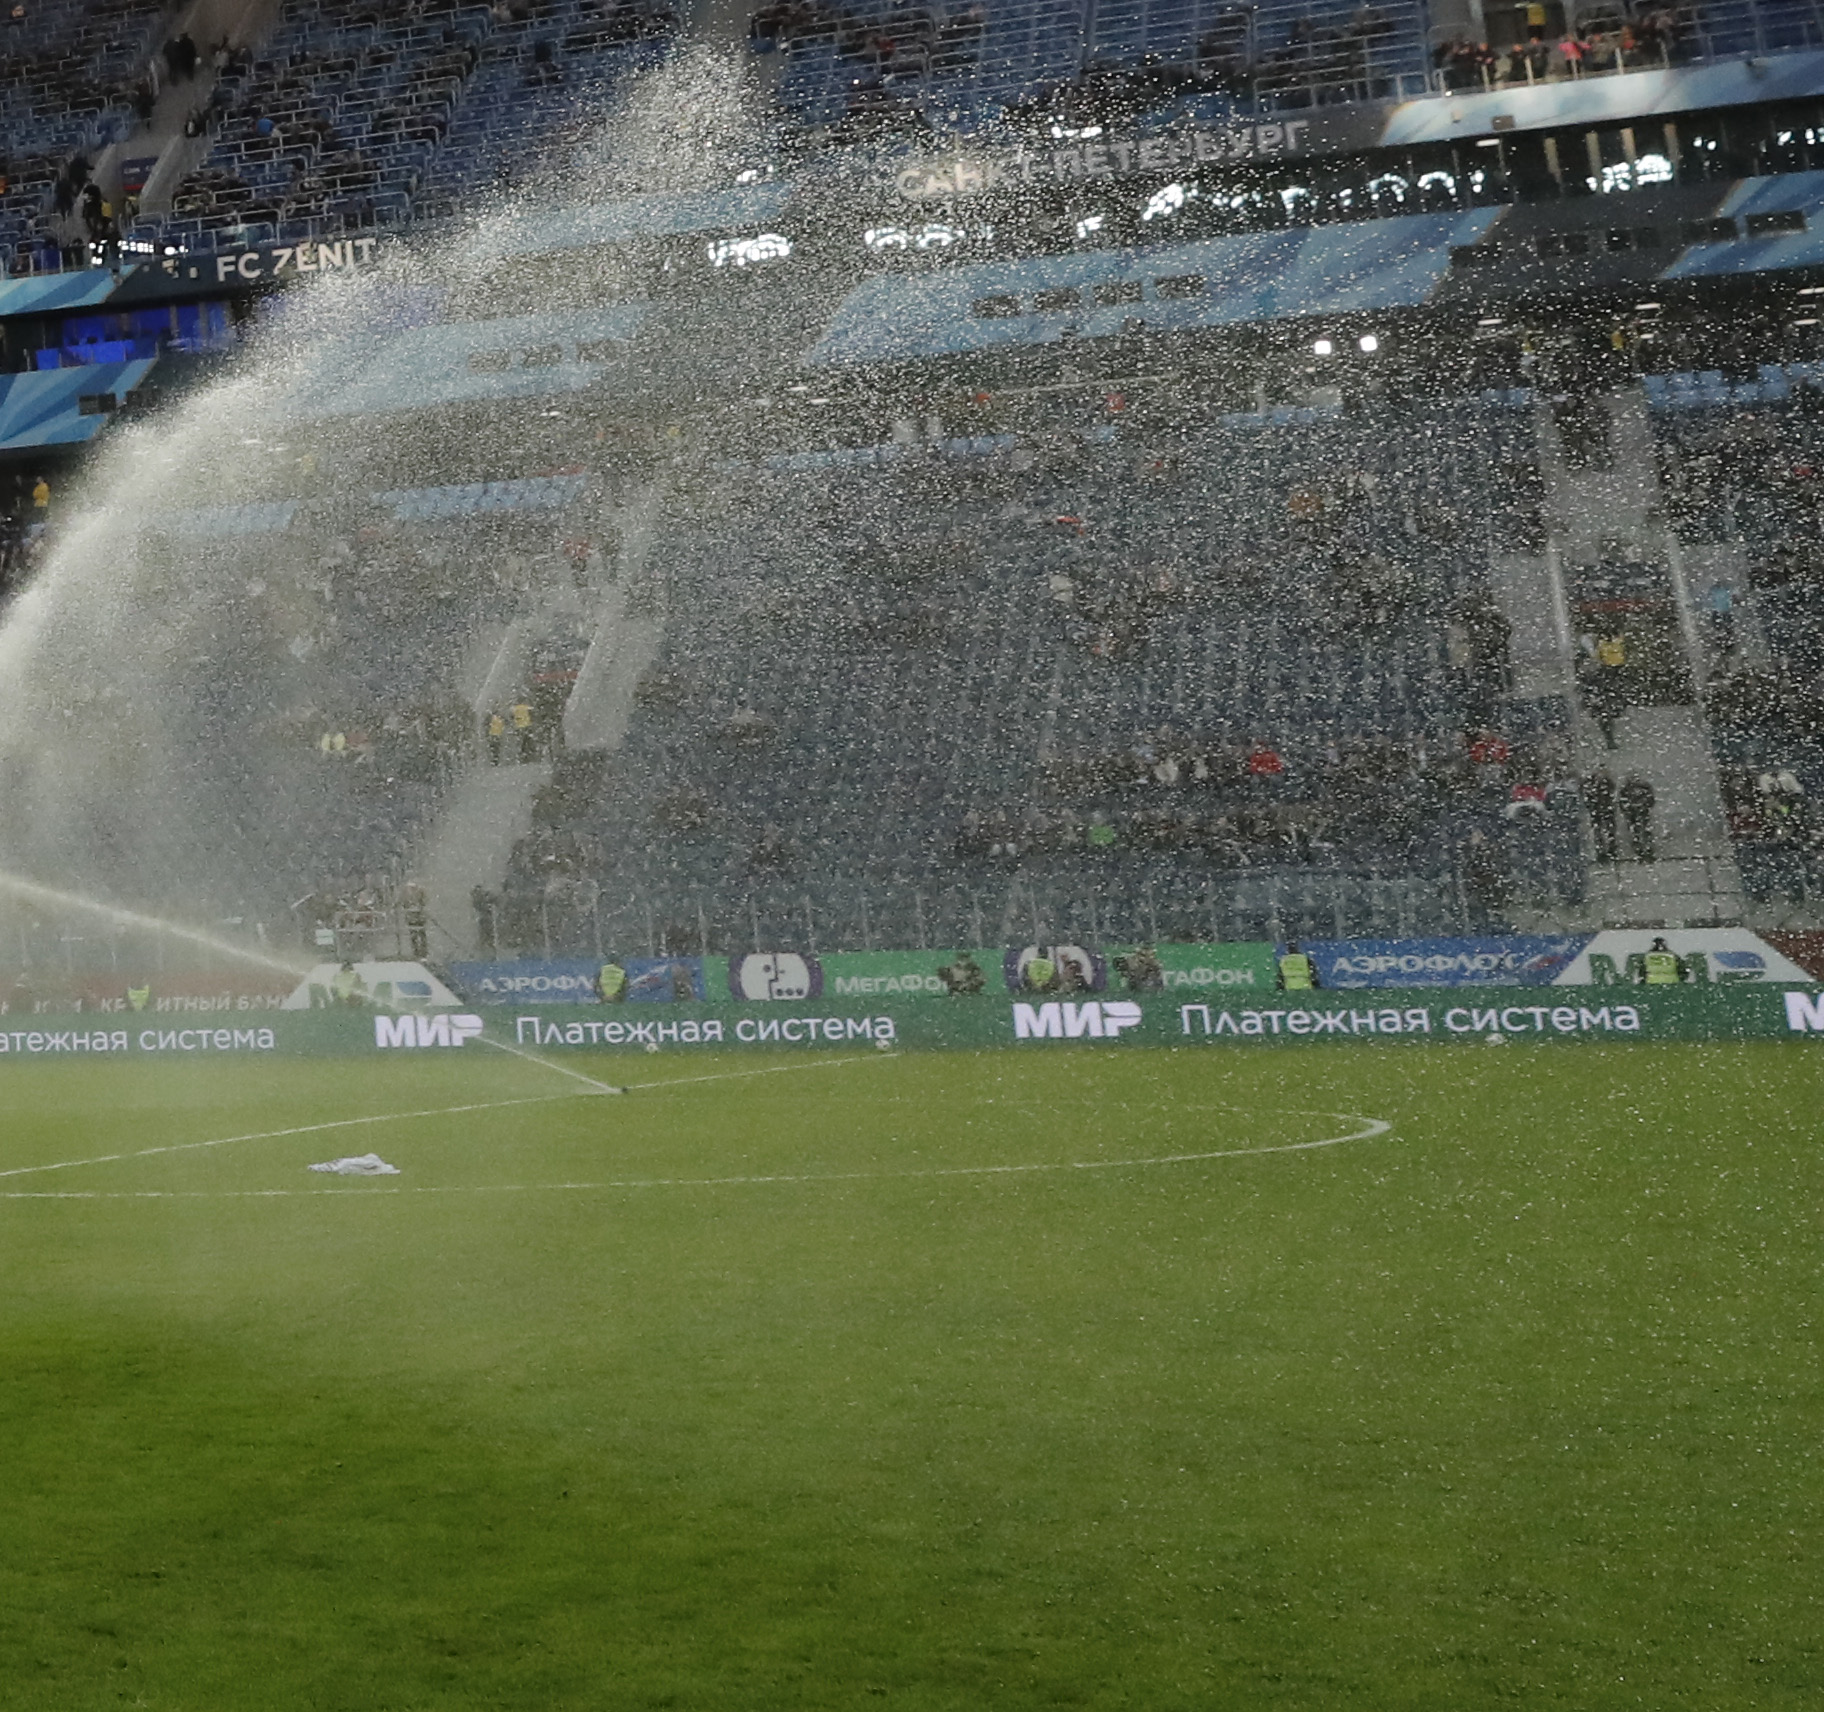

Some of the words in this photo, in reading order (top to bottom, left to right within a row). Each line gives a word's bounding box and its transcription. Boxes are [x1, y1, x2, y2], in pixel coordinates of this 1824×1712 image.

[217, 253, 261, 282] FC
[374, 1013, 484, 1047] МИР
[516, 1016, 723, 1045] Платежная
[735, 1014, 895, 1041] система
[1012, 1001, 1142, 1038] МИР
[1182, 1004, 1429, 1035] Платежная
[1444, 1001, 1640, 1031] система
[139, 1028, 275, 1051] система
